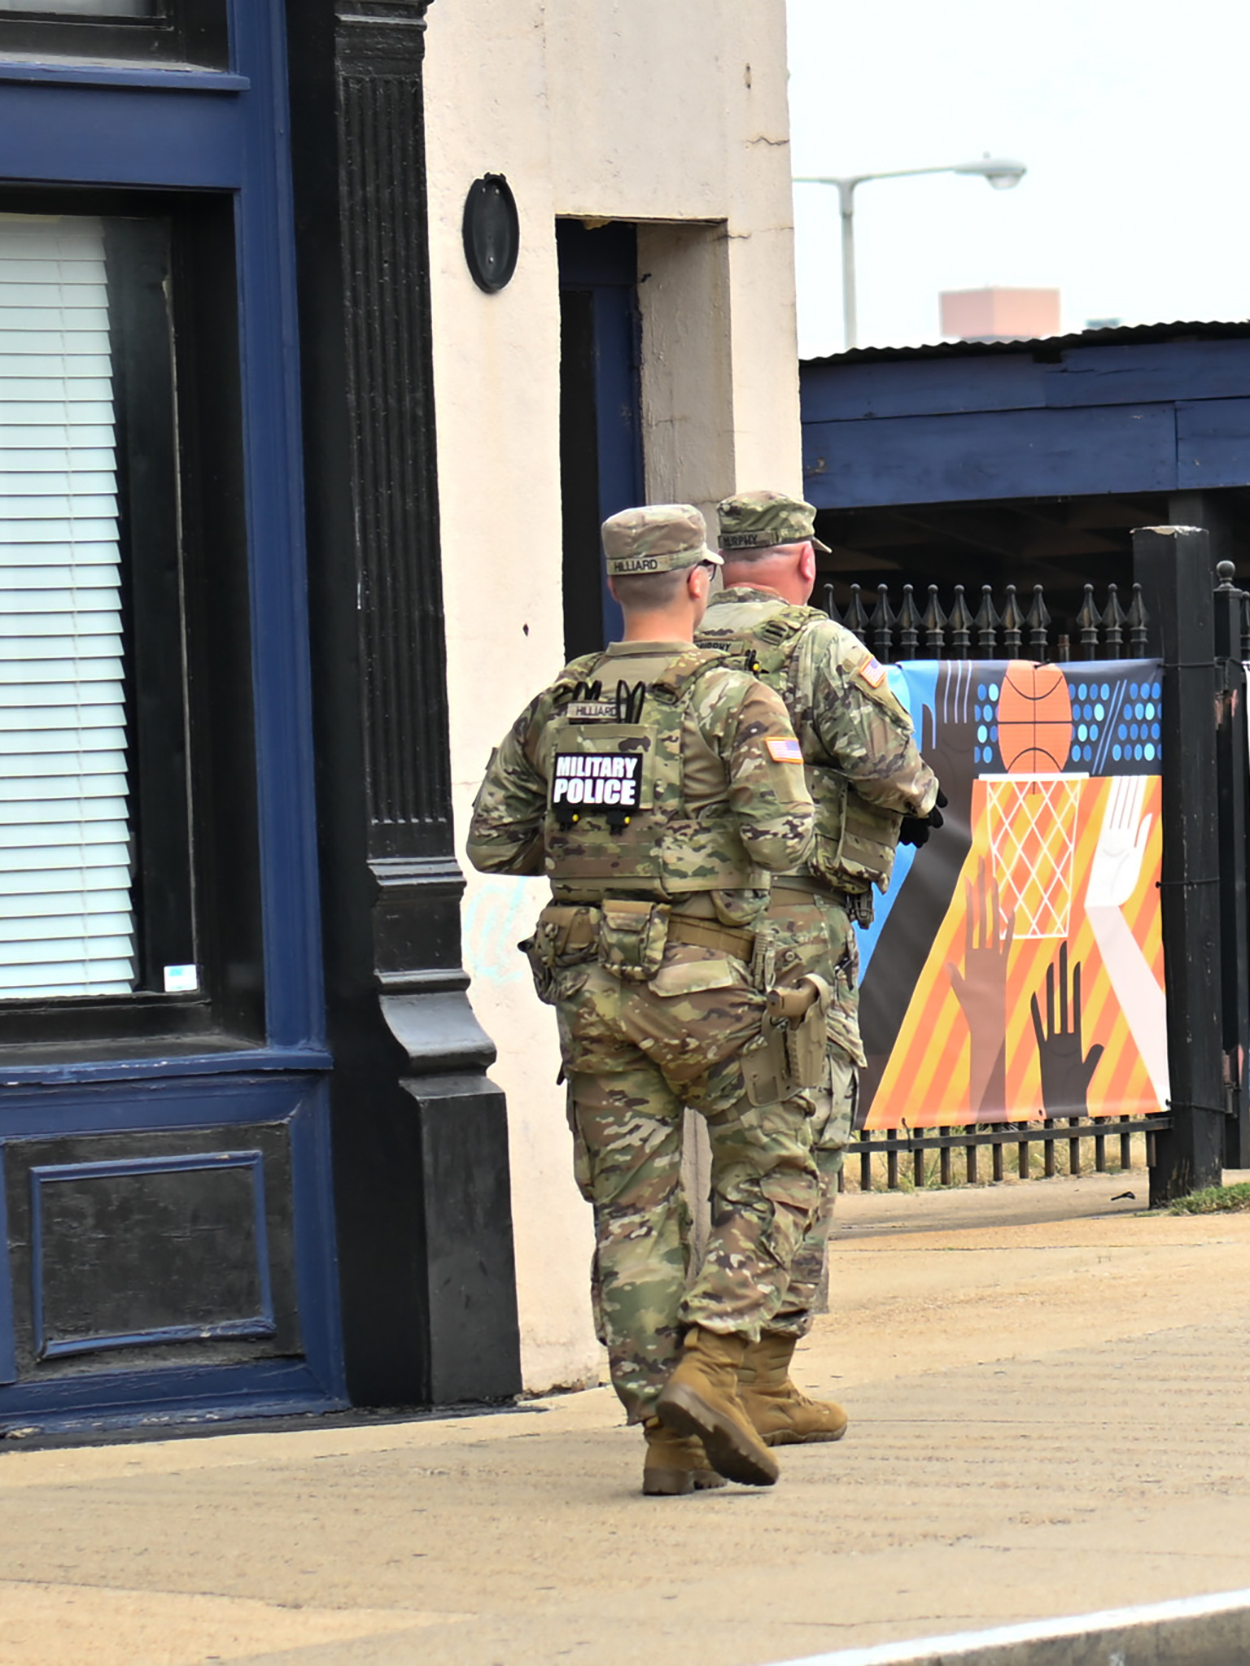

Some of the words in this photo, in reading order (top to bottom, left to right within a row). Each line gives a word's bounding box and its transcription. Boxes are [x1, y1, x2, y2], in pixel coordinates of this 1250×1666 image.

[723, 534, 758, 548] MURPHY
[614, 558, 658, 572] HILLIARD
[576, 704, 618, 717] HILLIARD
[556, 756, 638, 778] MILITARY
[553, 778, 637, 806] POLICE
